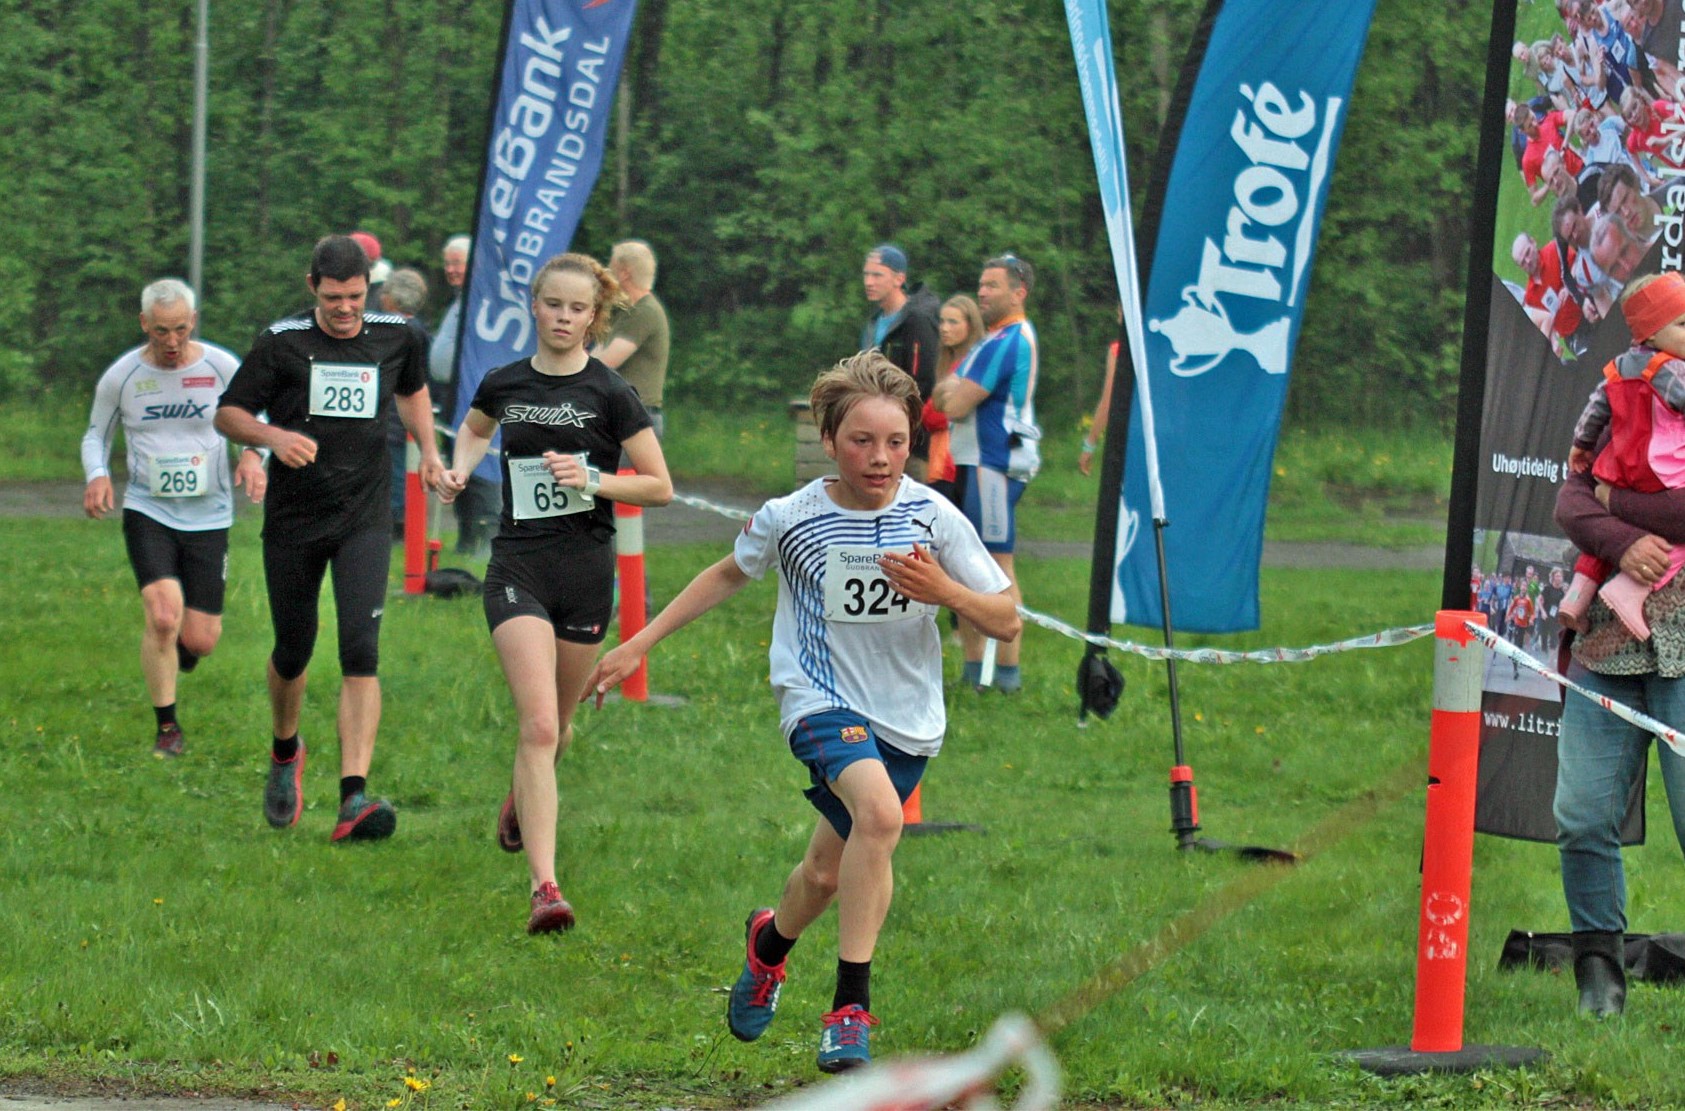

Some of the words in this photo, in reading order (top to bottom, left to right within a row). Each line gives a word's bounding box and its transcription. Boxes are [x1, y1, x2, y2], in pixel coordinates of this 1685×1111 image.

[510, 35, 611, 286] DBRANDSDAL
[1196, 81, 1316, 311] Trofé
[322, 385, 366, 413] 283
[160, 470, 198, 493] 269
[534, 482, 569, 512] 65
[843, 578, 911, 617] 324
[1483, 712, 1562, 737] www.litri
